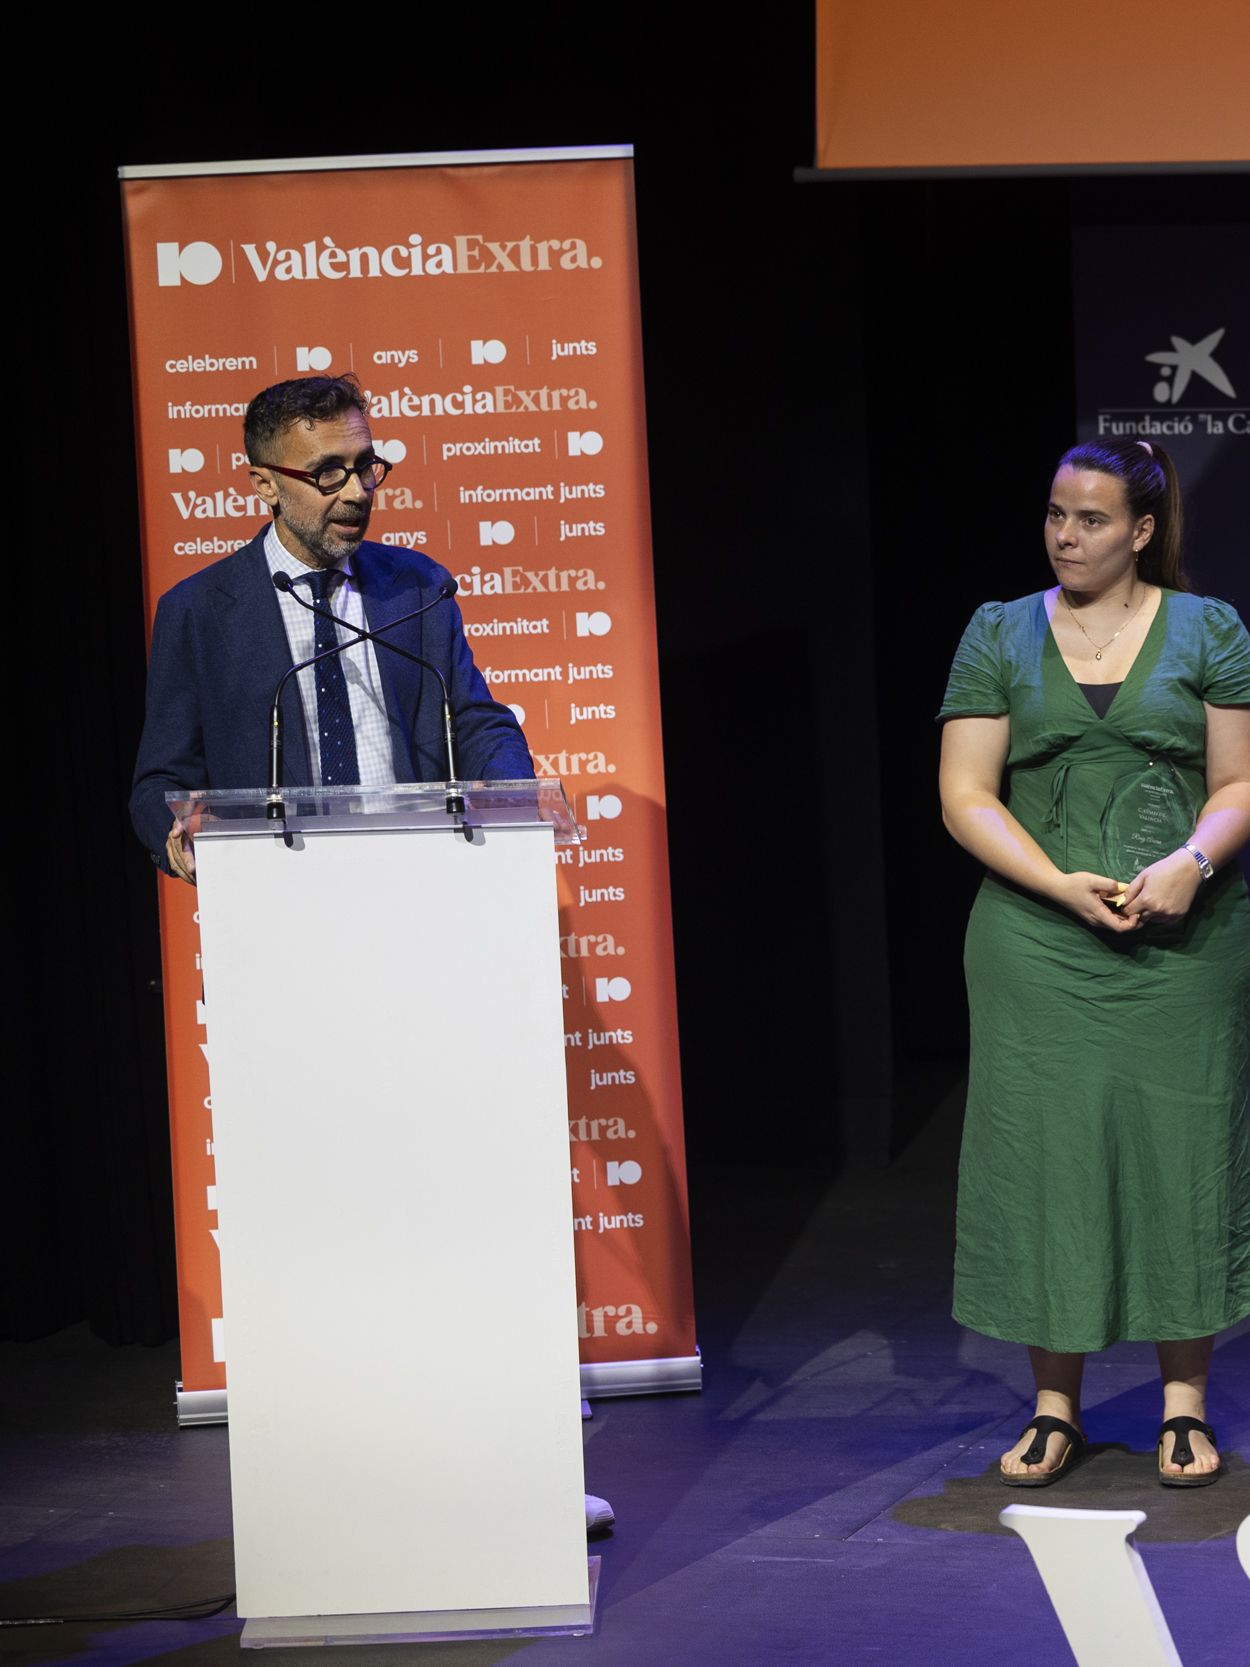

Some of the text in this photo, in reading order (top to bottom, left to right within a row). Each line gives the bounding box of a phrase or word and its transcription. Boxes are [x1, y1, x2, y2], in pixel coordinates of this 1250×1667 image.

[241, 234, 603, 283] ValènciaExtra.
[165, 354, 257, 373] celebrem
[373, 347, 418, 367] anys
[551, 338, 597, 358] junts
[1098, 414, 1193, 435] Fundació
[442, 437, 541, 460] proximitat
[171, 487, 272, 520] Valèn
[459, 481, 605, 504] informant junts
[381, 529, 427, 549] anys
[560, 519, 606, 542] junts
[455, 566, 606, 597] ciaExtra.
[464, 617, 549, 637] roximitat
[482, 663, 613, 684] formant junts
[570, 703, 616, 725] junts
[578, 847, 624, 867] junts
[579, 886, 625, 907] junts
[587, 1027, 634, 1049] junts
[590, 1067, 636, 1090] junts
[598, 1211, 644, 1234] junts
